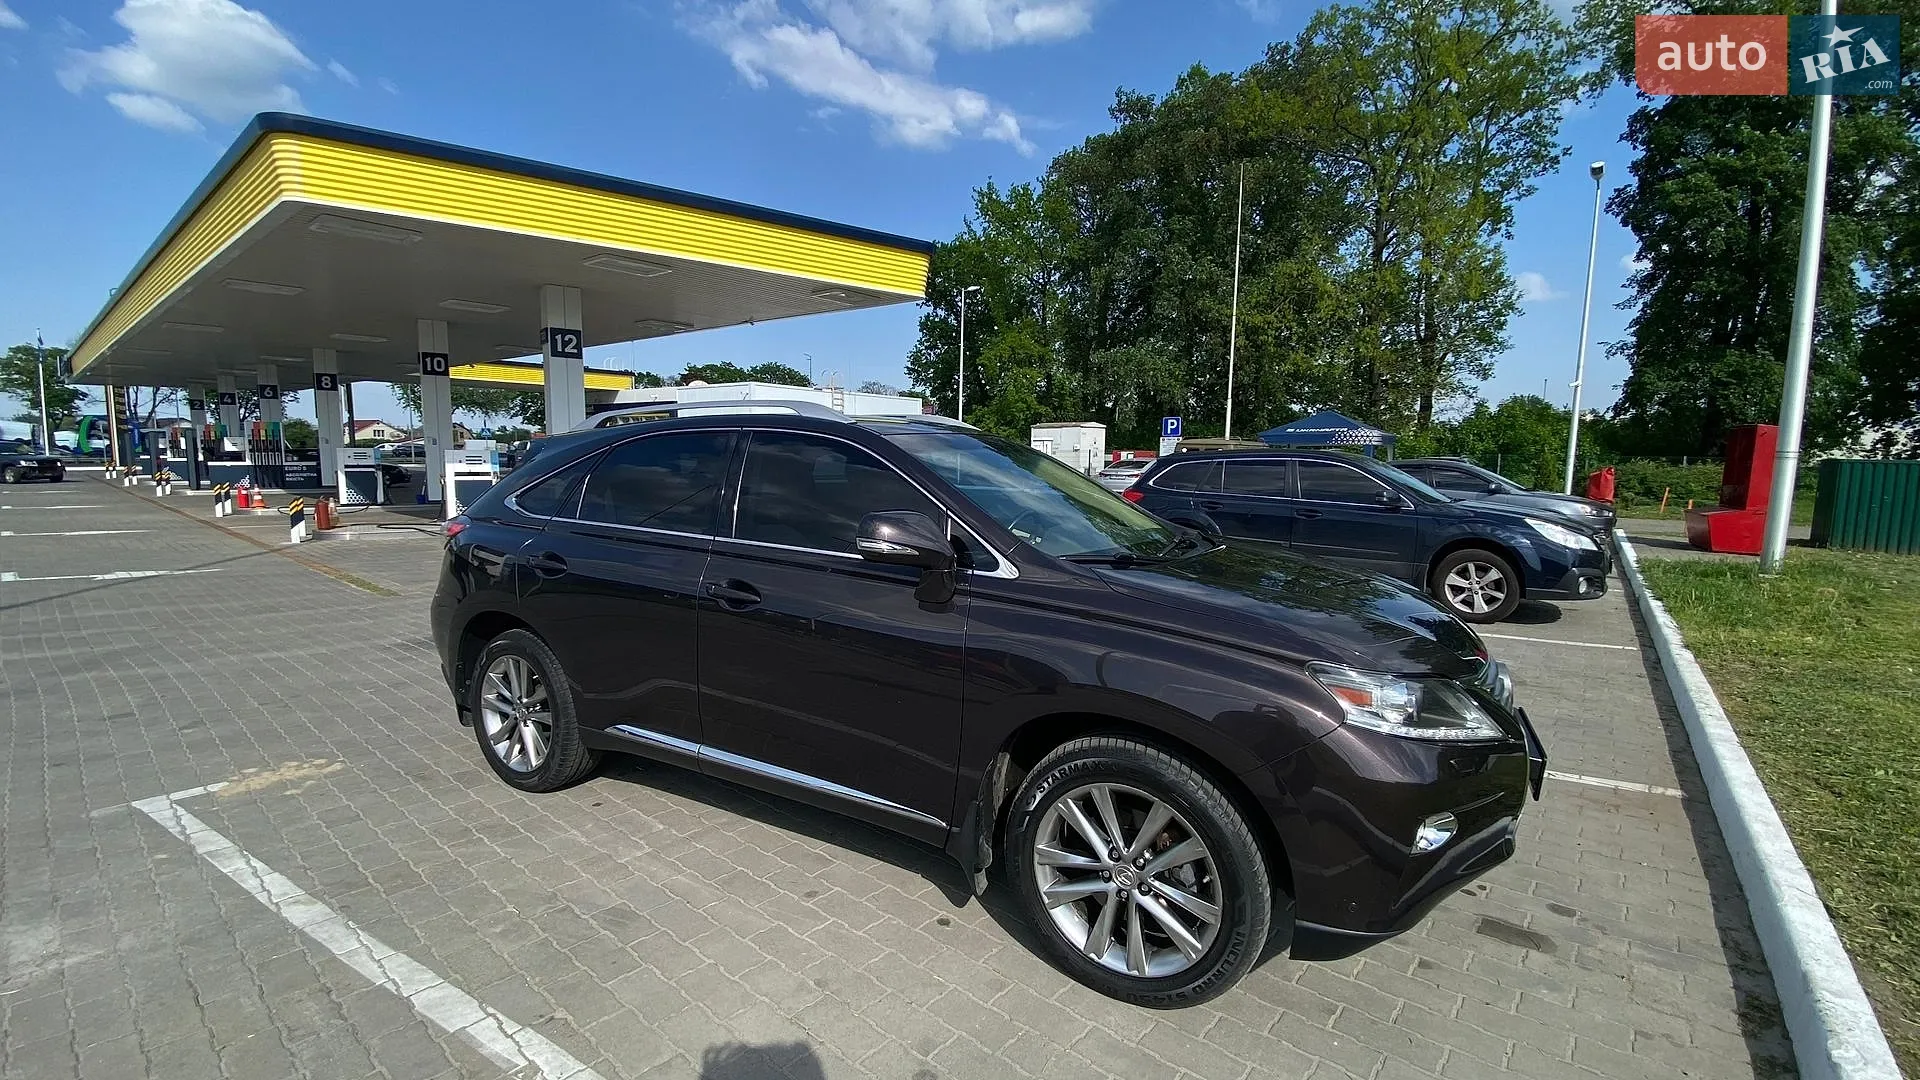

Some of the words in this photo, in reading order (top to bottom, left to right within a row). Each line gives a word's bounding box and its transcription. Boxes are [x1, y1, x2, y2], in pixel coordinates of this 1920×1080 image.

[555, 334, 578, 353] 12
[425, 357, 445, 372] 10
[321, 376, 332, 388] 8
[263, 387, 273, 397] 6
[223, 394, 231, 403] 4
[193, 401, 201, 409] 2
[1167, 419, 1178, 434] P
